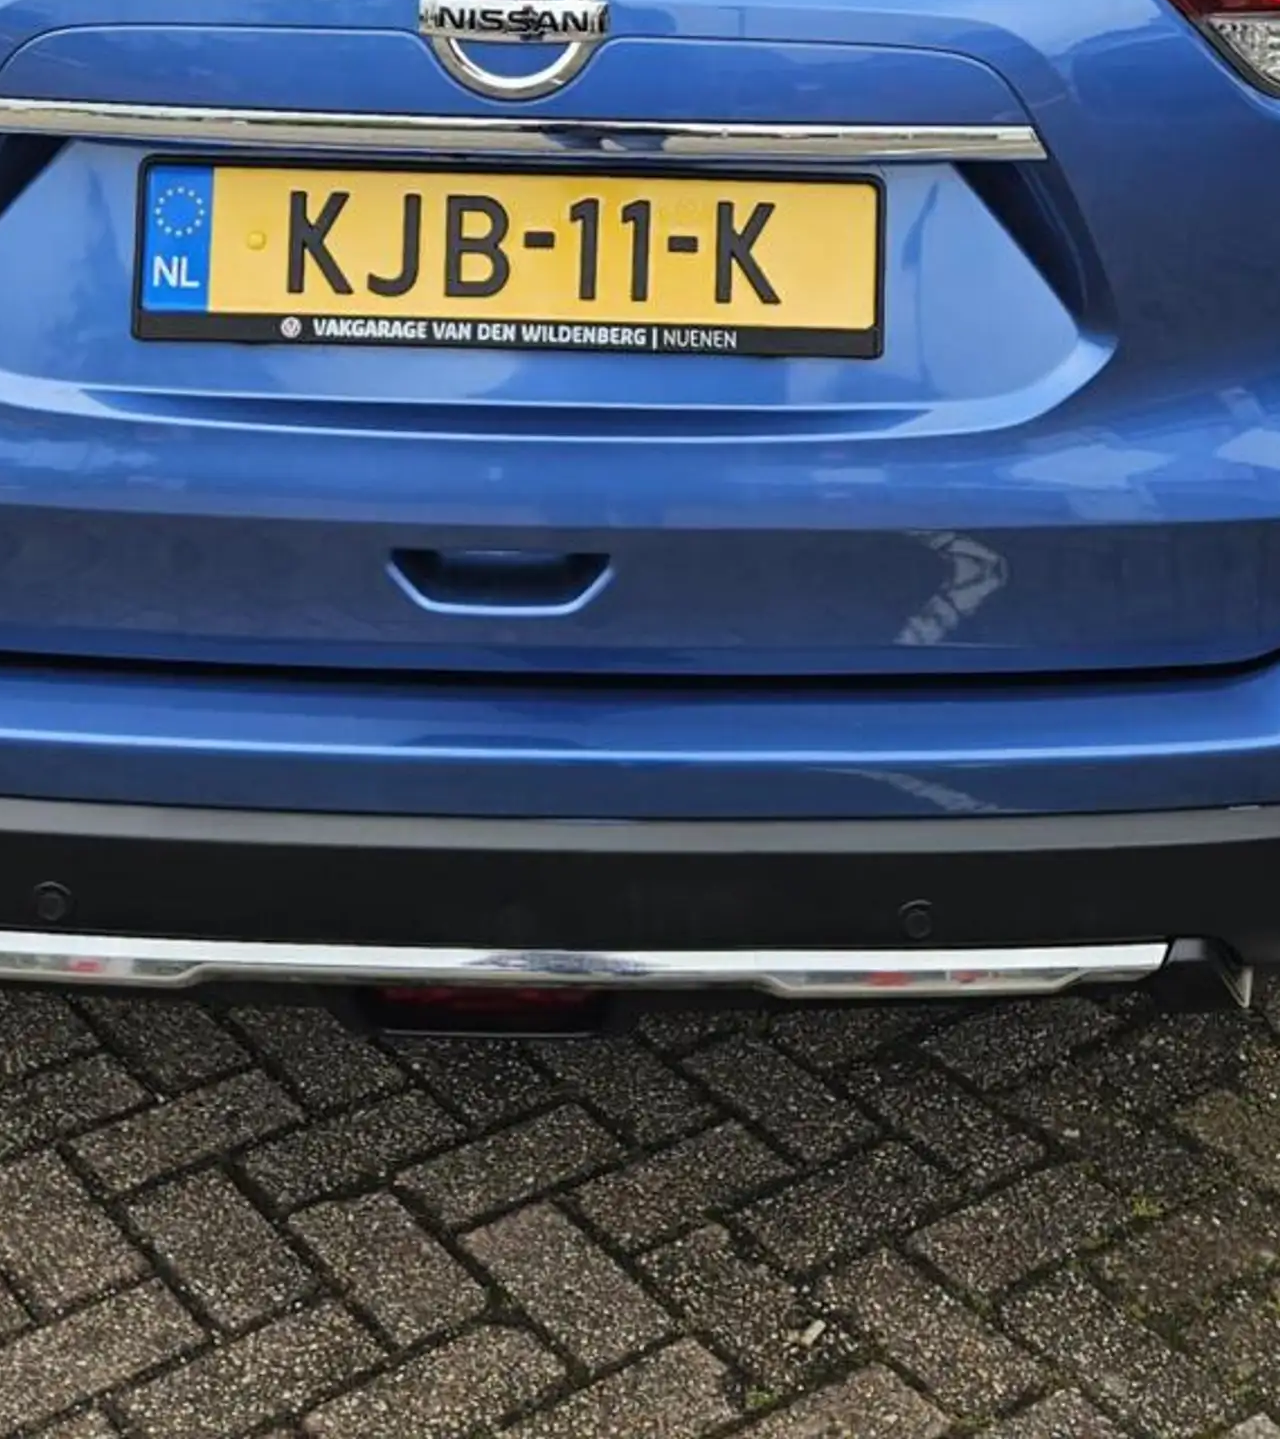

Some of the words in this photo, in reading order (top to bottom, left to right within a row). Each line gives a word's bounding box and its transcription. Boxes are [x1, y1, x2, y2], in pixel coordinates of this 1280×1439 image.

[437, 6, 588, 34] NISSAN
[286, 189, 781, 306] KJB-11-K
[152, 255, 200, 290] NL
[313, 317, 427, 339] VAKGARAGE
[432, 321, 471, 340] VAN
[477, 323, 516, 342] DEN
[521, 323, 646, 346] WILDENBERG
[663, 327, 738, 349] NUENEN
